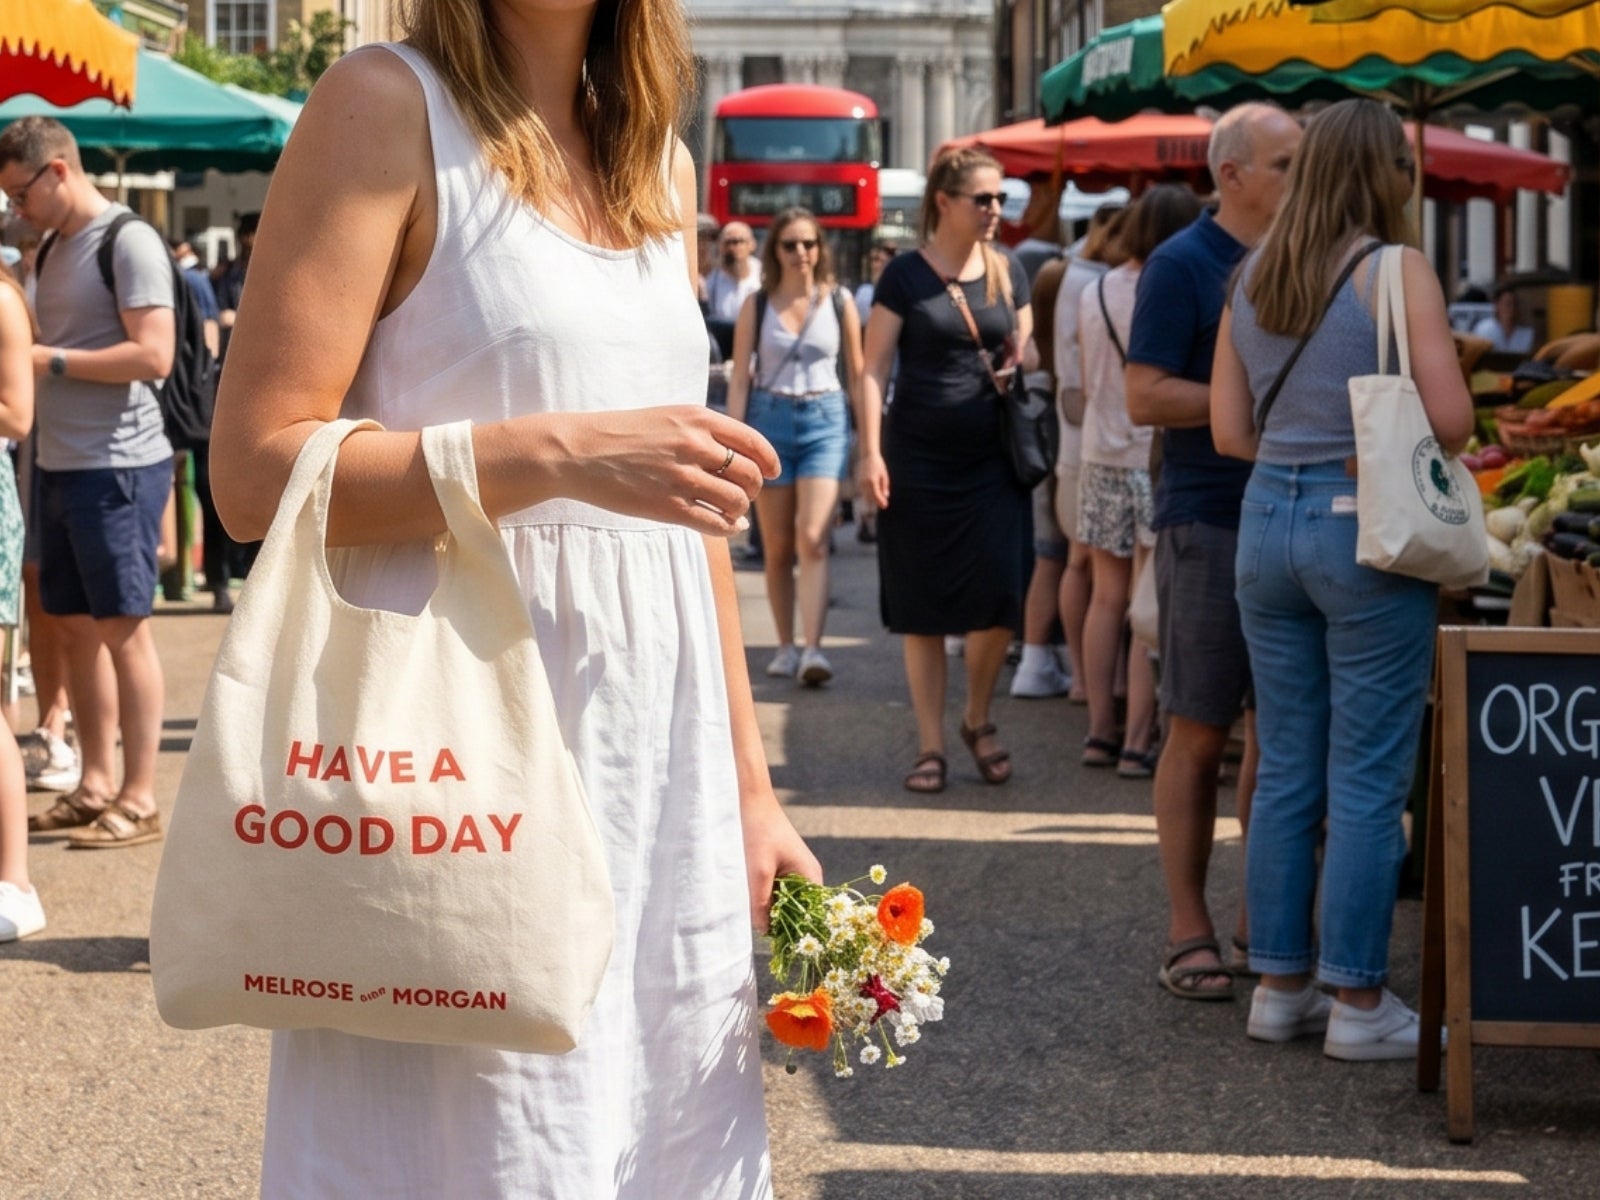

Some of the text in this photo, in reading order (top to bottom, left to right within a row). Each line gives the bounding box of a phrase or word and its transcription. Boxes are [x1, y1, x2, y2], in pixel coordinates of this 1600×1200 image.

[285, 741, 466, 783] HAVE A
[234, 804, 522, 855] GOOD DAY
[1539, 776, 1600, 847] V
[244, 974, 354, 1001] MELROSE
[392, 988, 507, 1010] MORGAN
